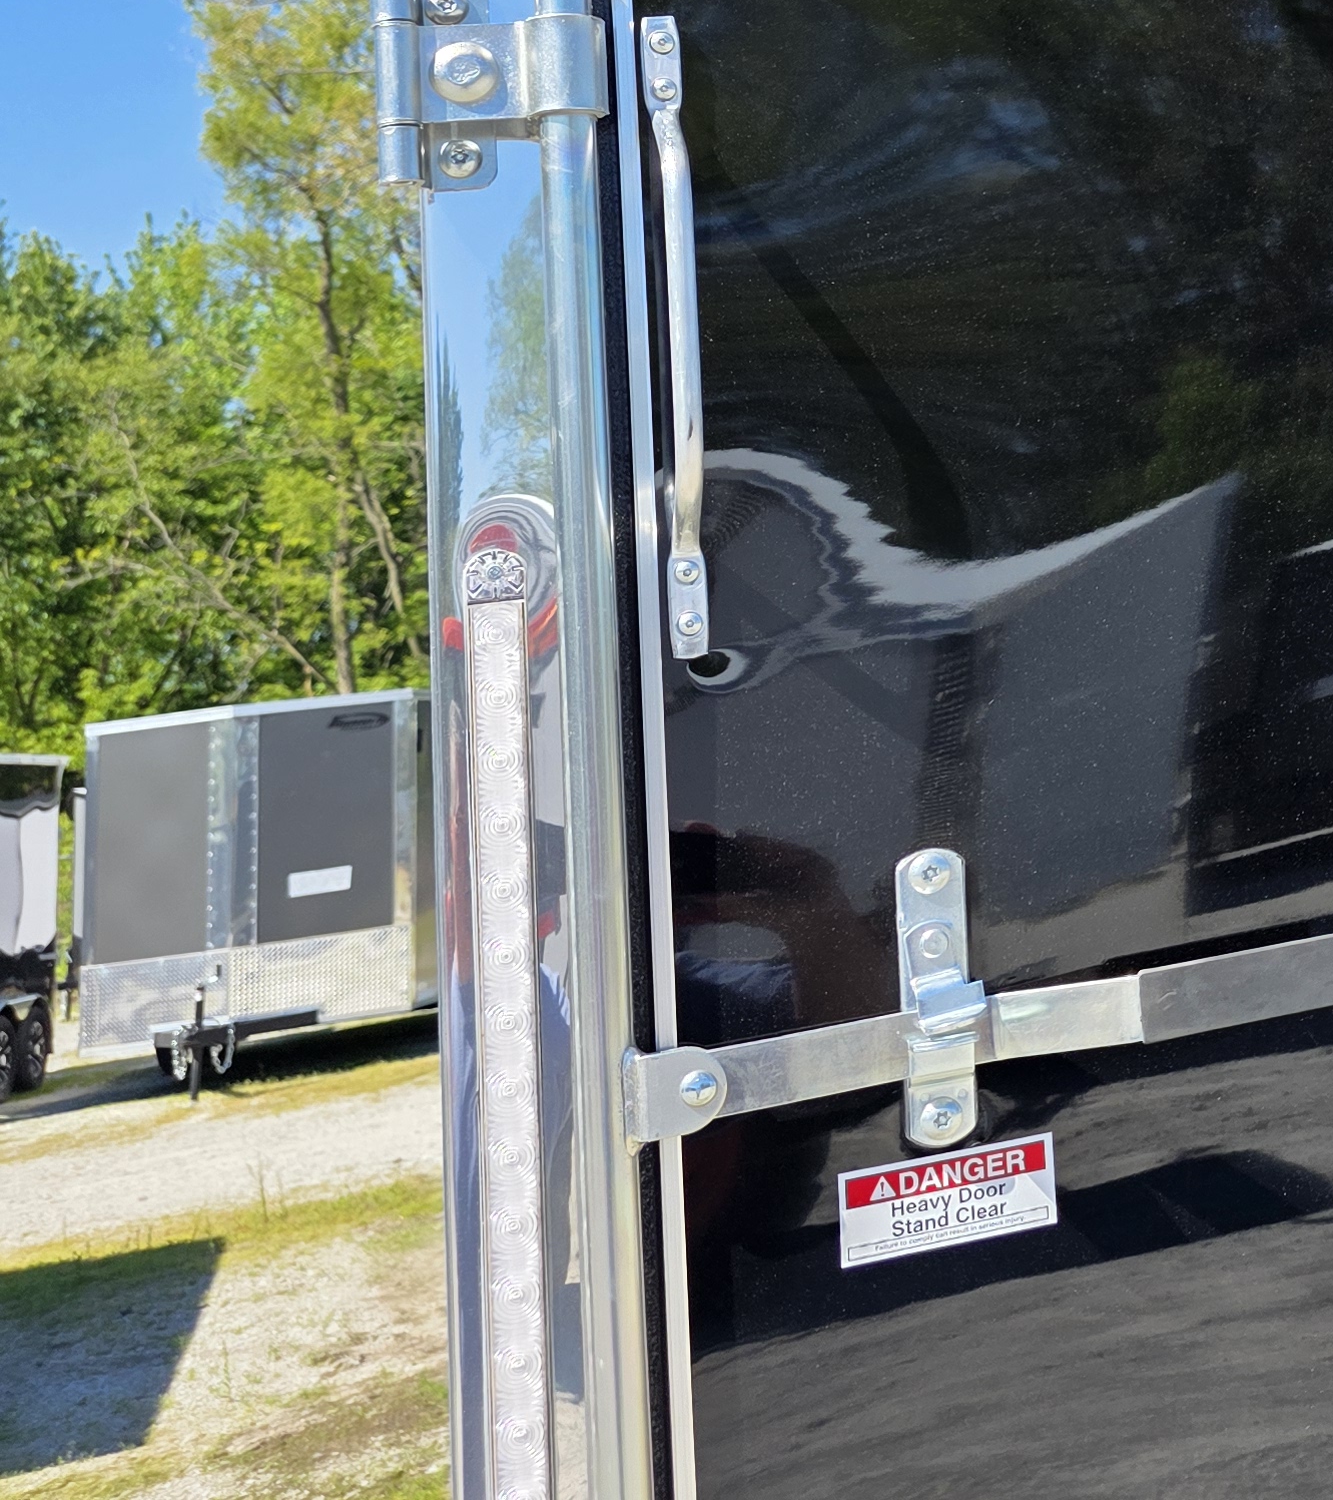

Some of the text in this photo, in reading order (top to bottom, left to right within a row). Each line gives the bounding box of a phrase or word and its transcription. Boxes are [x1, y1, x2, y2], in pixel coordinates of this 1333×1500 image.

[899, 1149, 1026, 1195] DANGER
[891, 1182, 1006, 1218] Heavy Door
[892, 1202, 1007, 1237] Stand Clear
